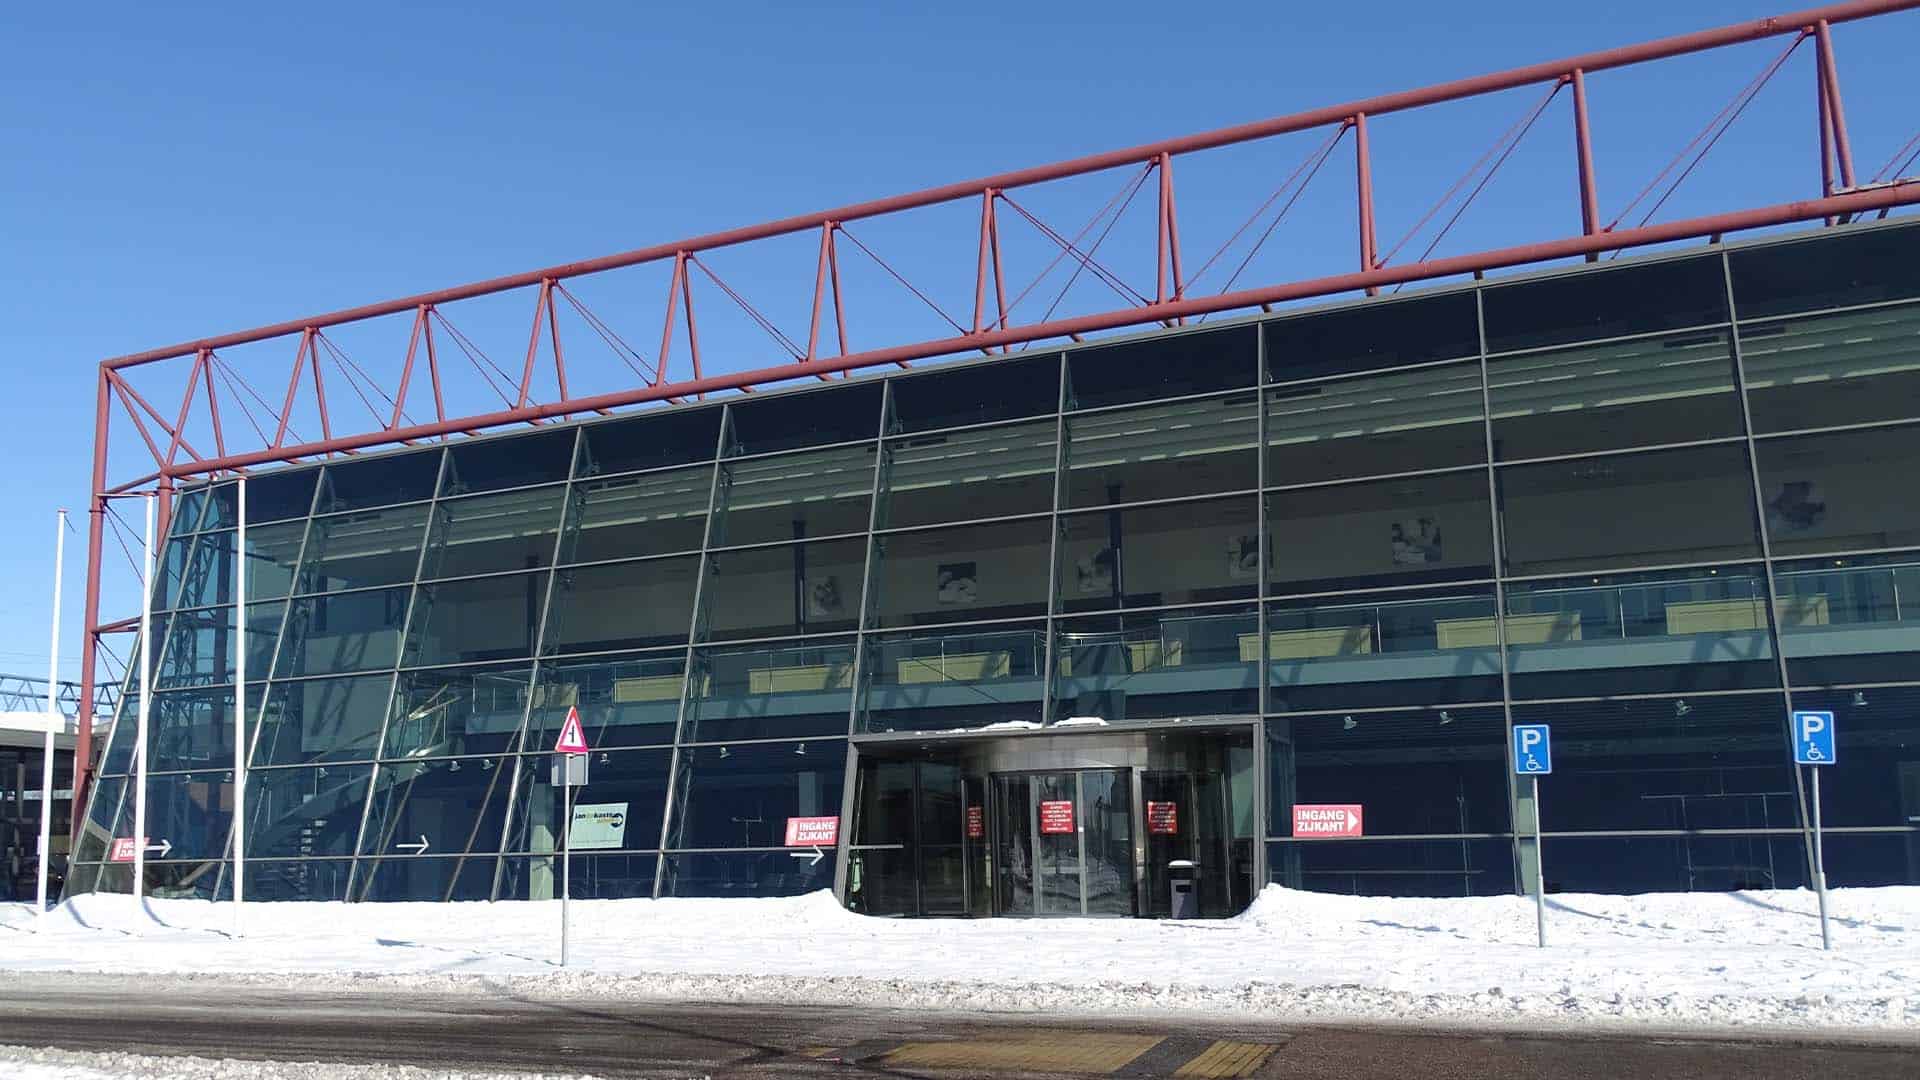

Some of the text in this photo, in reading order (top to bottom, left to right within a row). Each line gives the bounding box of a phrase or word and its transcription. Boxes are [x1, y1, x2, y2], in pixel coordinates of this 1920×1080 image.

[1802, 716, 1824, 741] P
[1522, 729, 1540, 753] P
[1297, 810, 1344, 820] INGANG
[799, 821, 834, 831] INGANG
[1297, 821, 1344, 832] ZIJKANT
[797, 831, 833, 841] ZIJKANT
